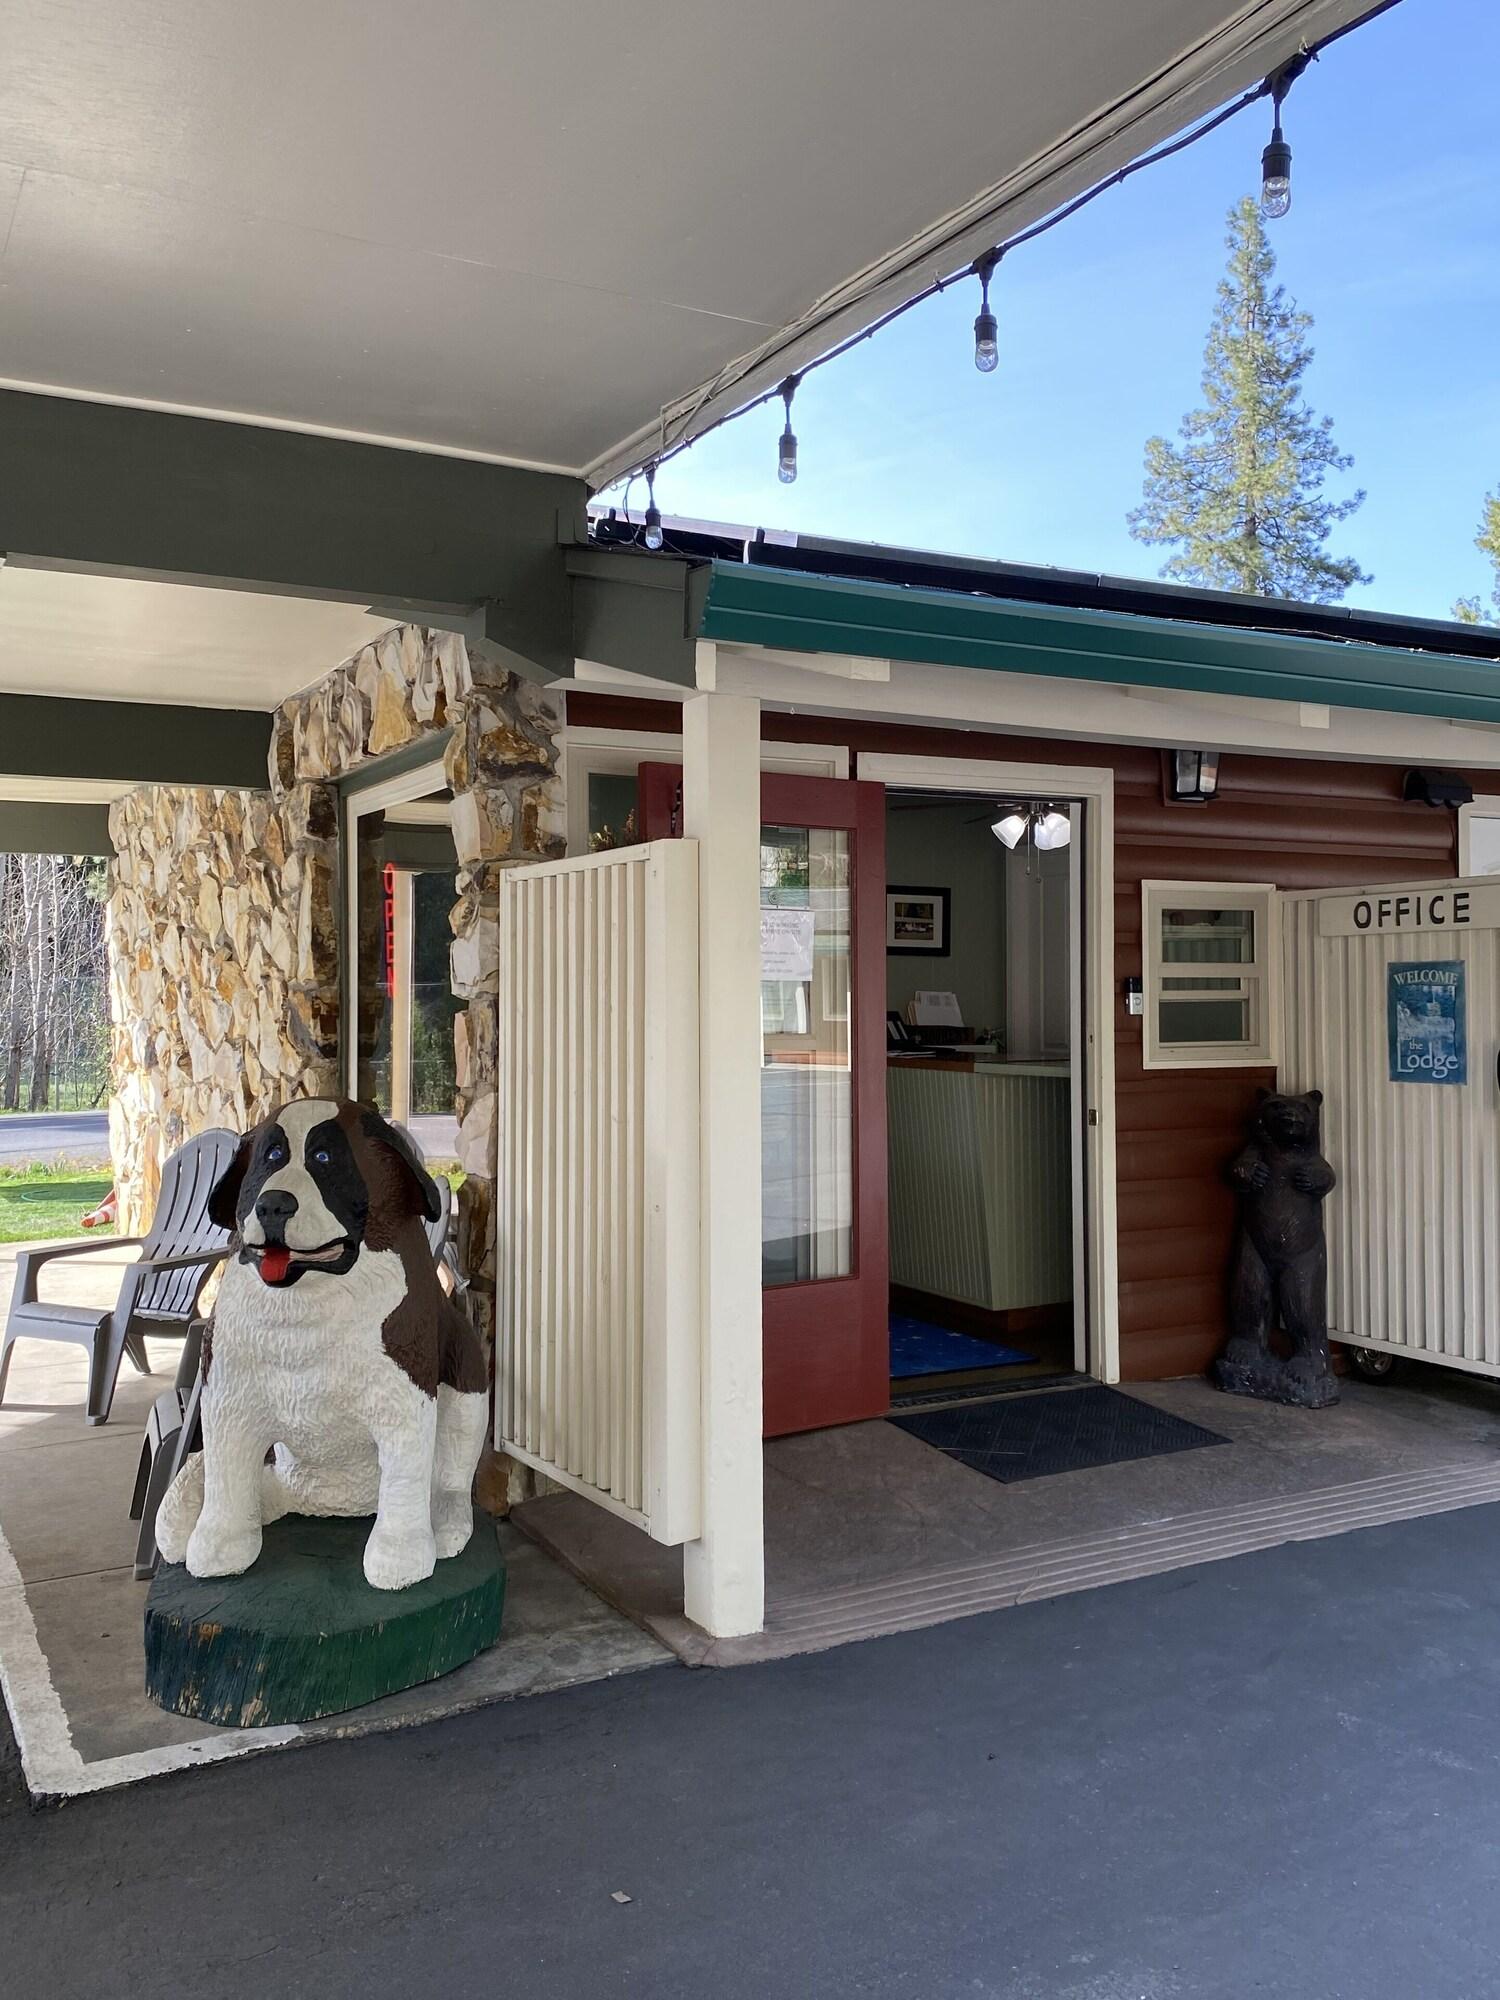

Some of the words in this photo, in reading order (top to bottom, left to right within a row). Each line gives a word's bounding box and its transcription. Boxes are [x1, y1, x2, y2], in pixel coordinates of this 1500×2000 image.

[1353, 892, 1470, 928] OFFICE
[1393, 969, 1458, 985] WELCOME
[1409, 1038, 1424, 1050] the
[1397, 1040, 1458, 1079] Lodge
